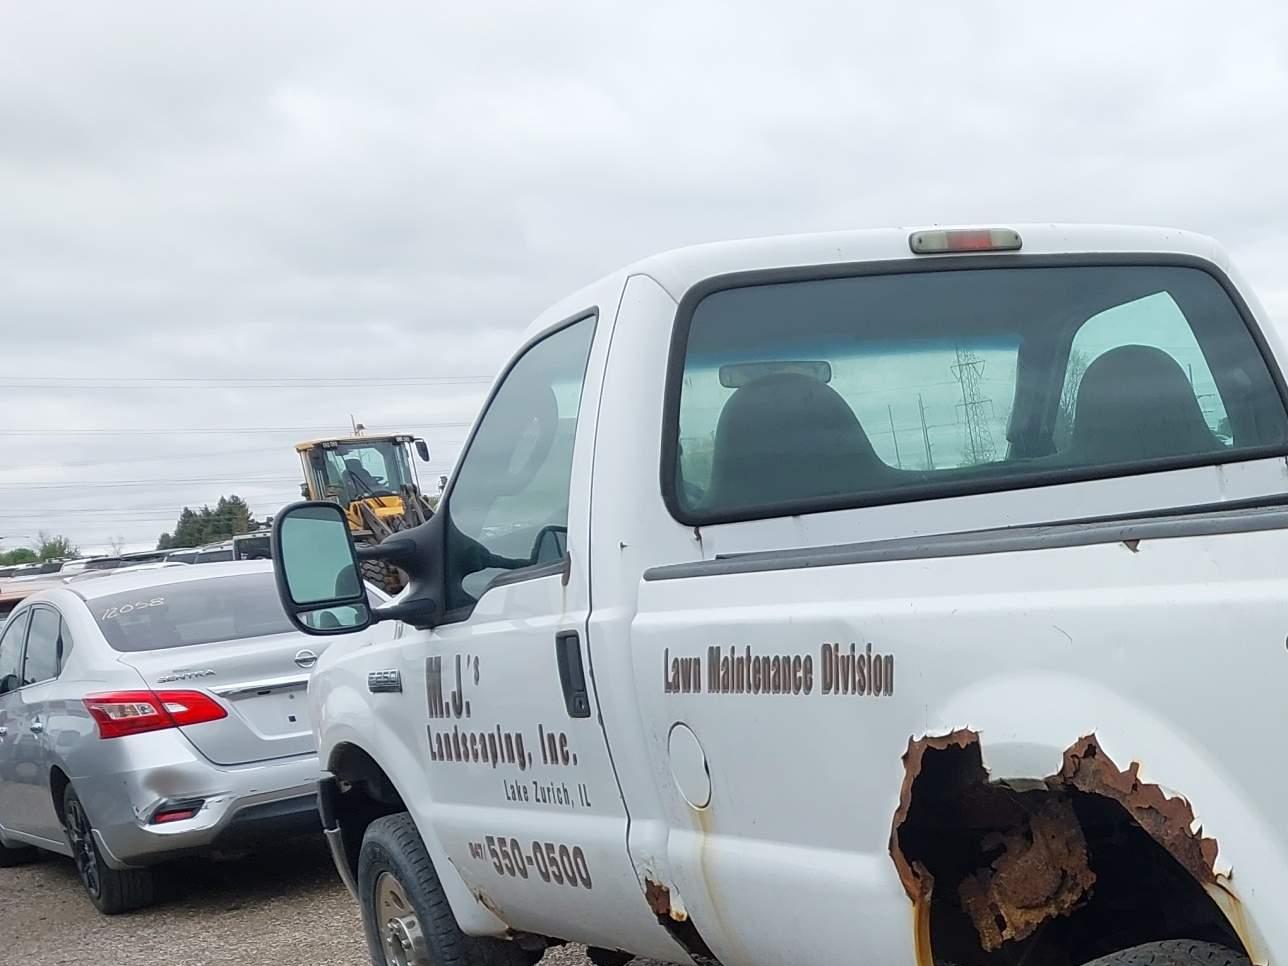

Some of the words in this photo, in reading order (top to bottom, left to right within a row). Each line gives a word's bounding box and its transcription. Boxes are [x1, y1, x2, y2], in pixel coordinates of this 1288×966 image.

[156, 669, 216, 683] SENTRA
[425, 654, 480, 719] M.J.'s
[664, 647, 701, 694] Lawn
[707, 645, 813, 695] Maintenance
[820, 643, 894, 696] Division
[427, 724, 533, 771] Landscaping,
[538, 724, 578, 766] Inc.
[503, 779, 529, 803] Lake
[533, 780, 575, 809] Zurich,
[578, 783, 592, 808] IL
